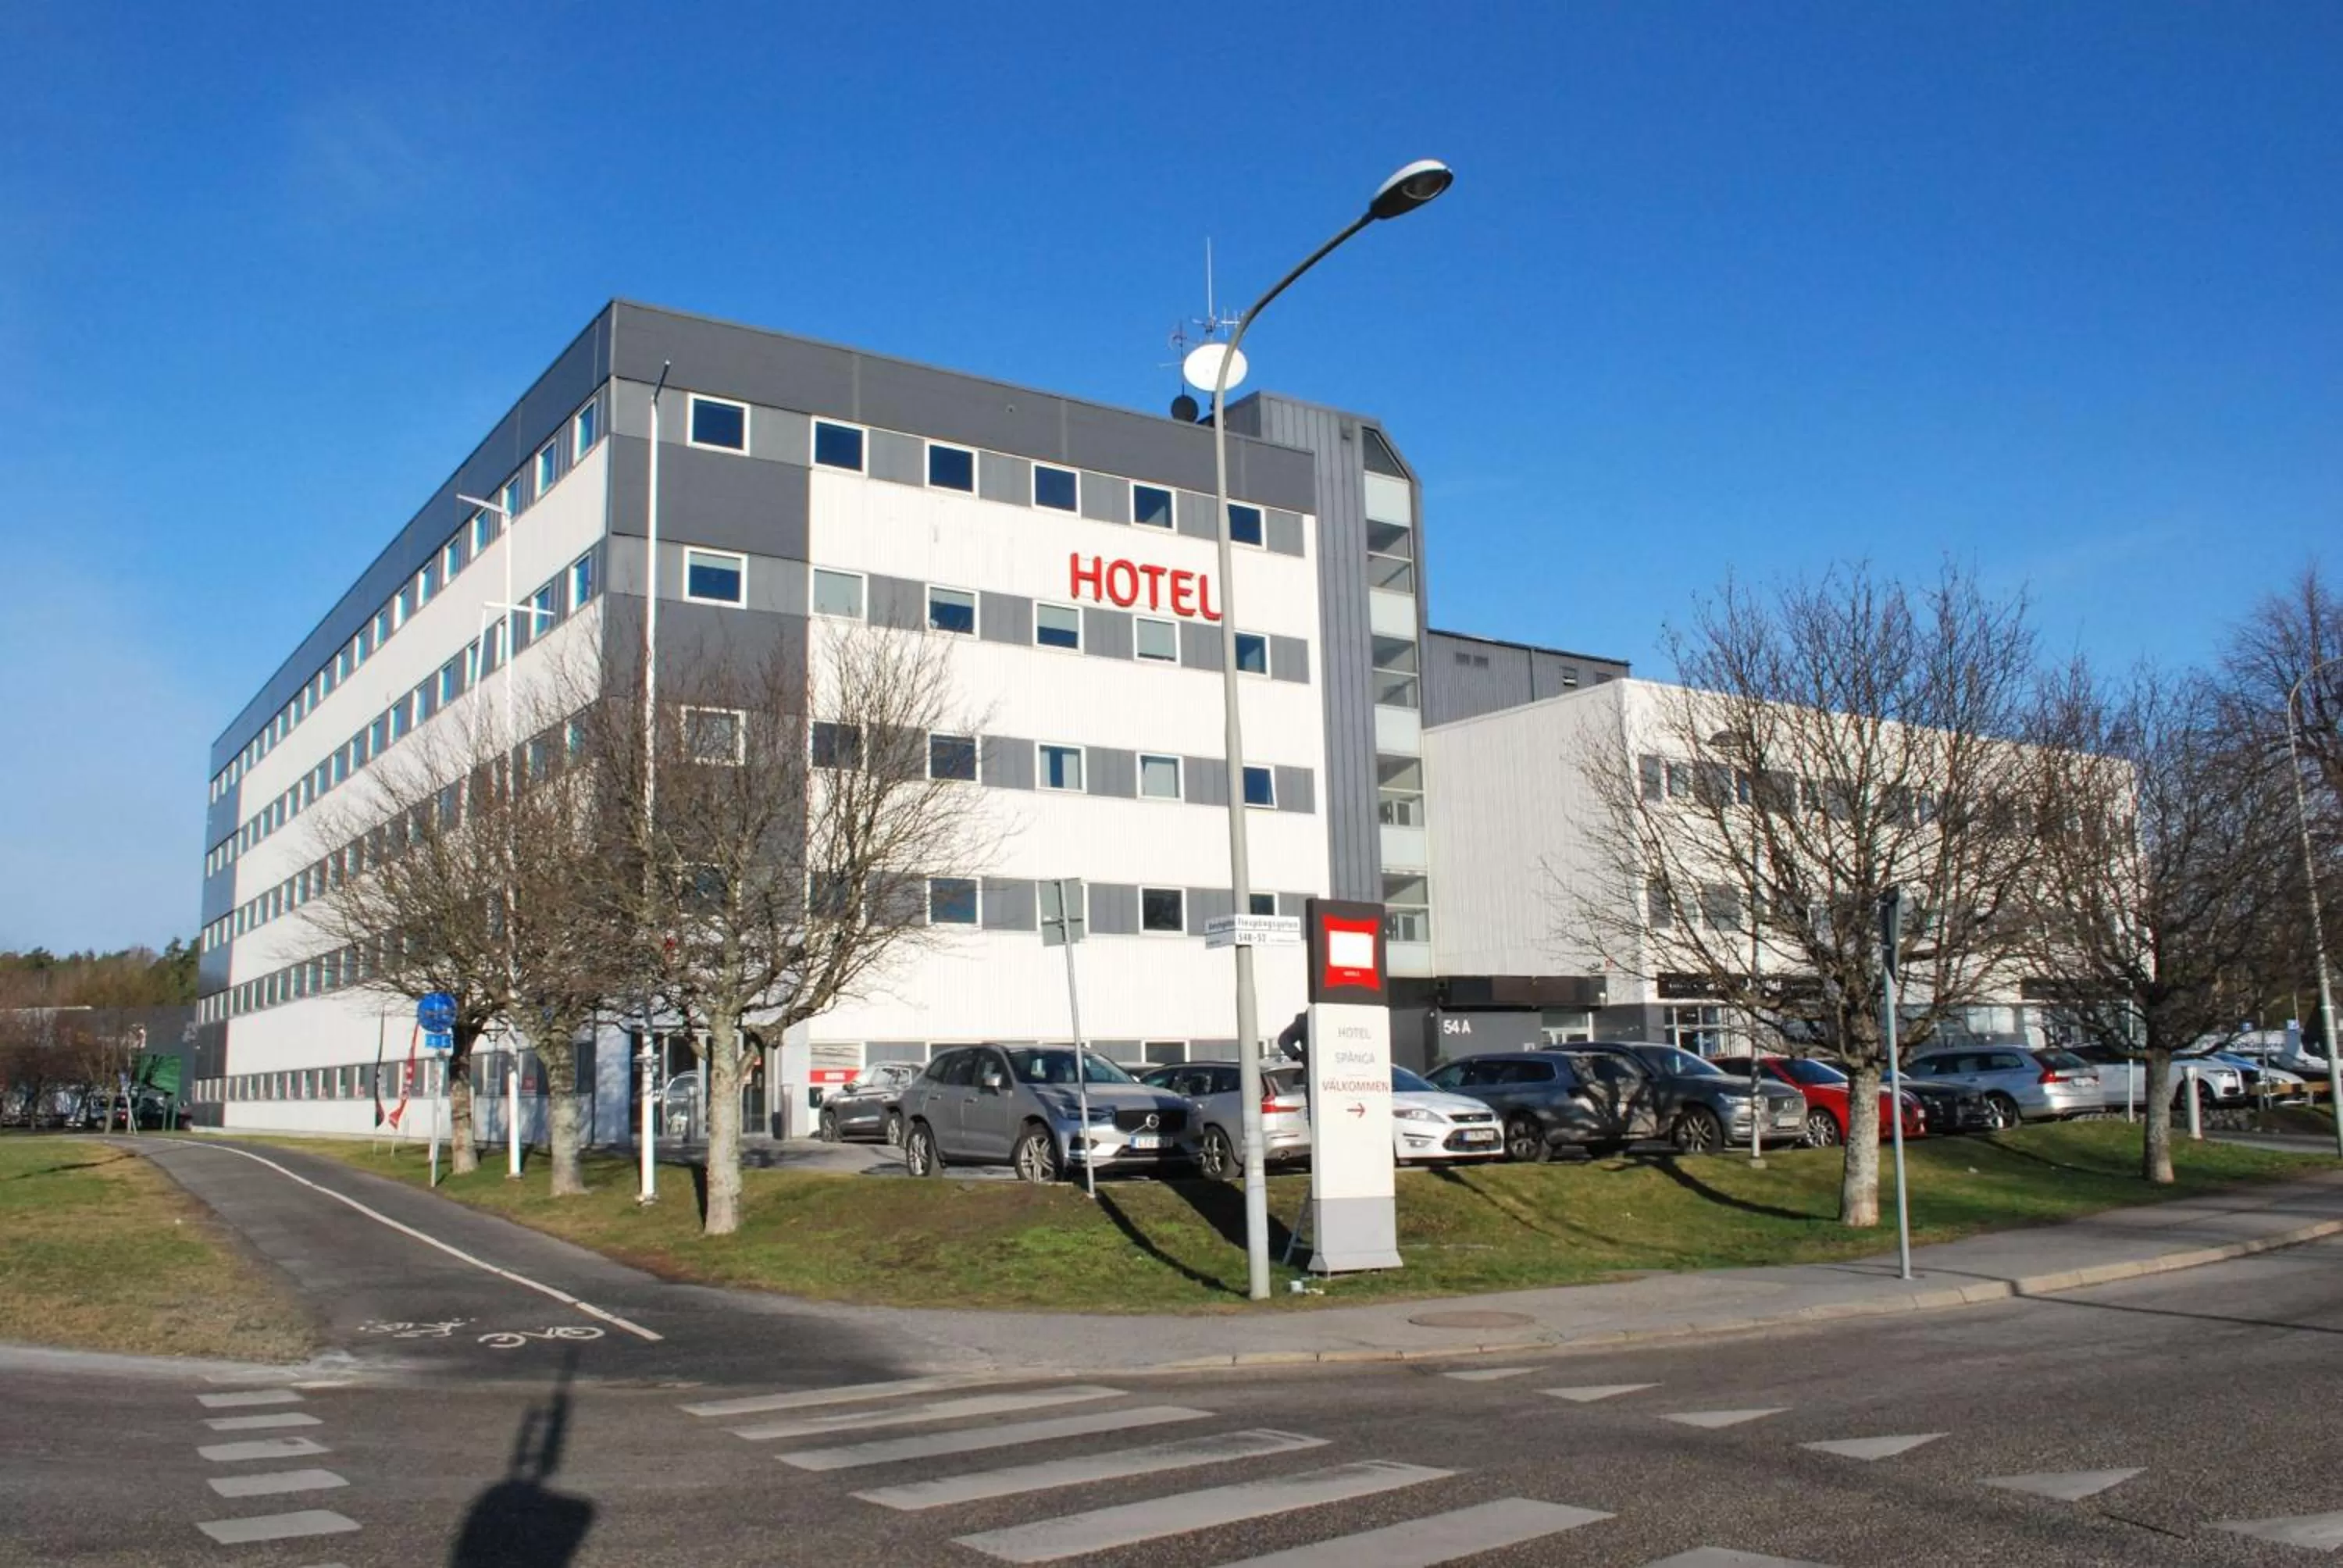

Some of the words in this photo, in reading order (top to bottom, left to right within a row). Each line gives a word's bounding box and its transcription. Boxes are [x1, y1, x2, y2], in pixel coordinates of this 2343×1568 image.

[1070, 552, 1223, 622] HOTEL
[1337, 1027, 1371, 1039] HOTEL
[1443, 1019, 1460, 1035] 54
[1461, 1019, 1472, 1035] A
[1335, 1050, 1375, 1064] SPÅNGA
[1322, 1079, 1389, 1093] VÄLKOMMEN
